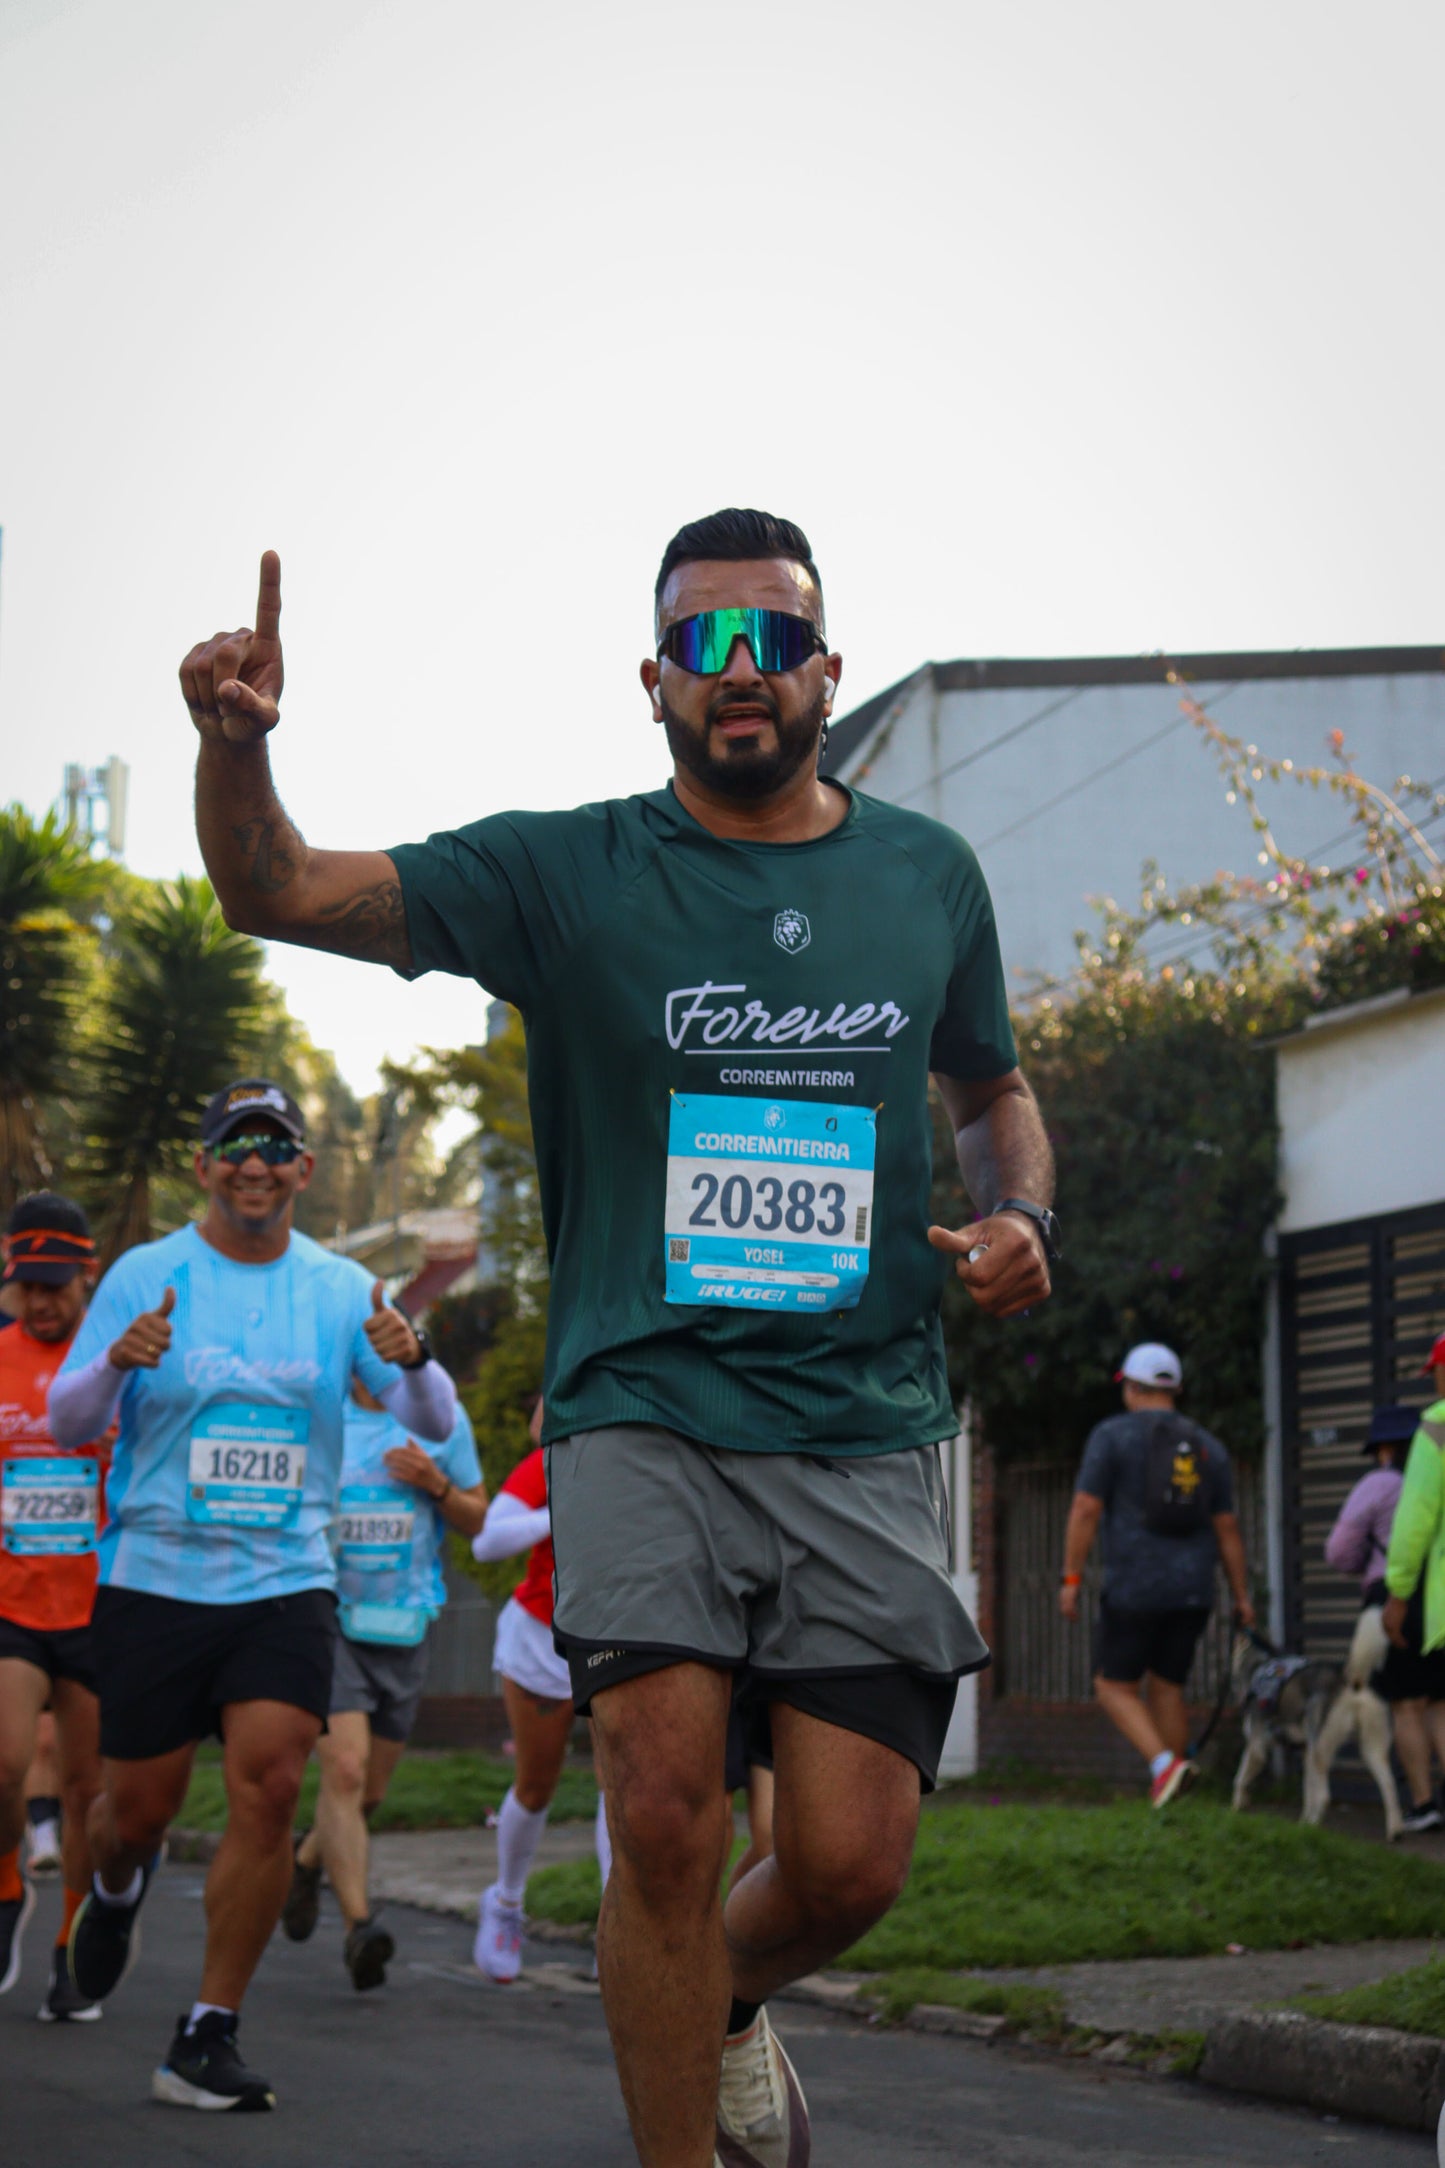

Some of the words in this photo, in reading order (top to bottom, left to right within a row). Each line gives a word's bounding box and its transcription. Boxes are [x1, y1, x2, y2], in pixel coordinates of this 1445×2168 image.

[665, 980, 910, 1050] Forever
[719, 1068, 855, 1087] CORREMITIERRA
[694, 1132, 851, 1161] CORREMITIERRA
[688, 1172, 846, 1237] 20383
[743, 1246, 786, 1265] YOSEL
[831, 1252, 859, 1270] 10K
[209, 1447, 290, 1484] 16218
